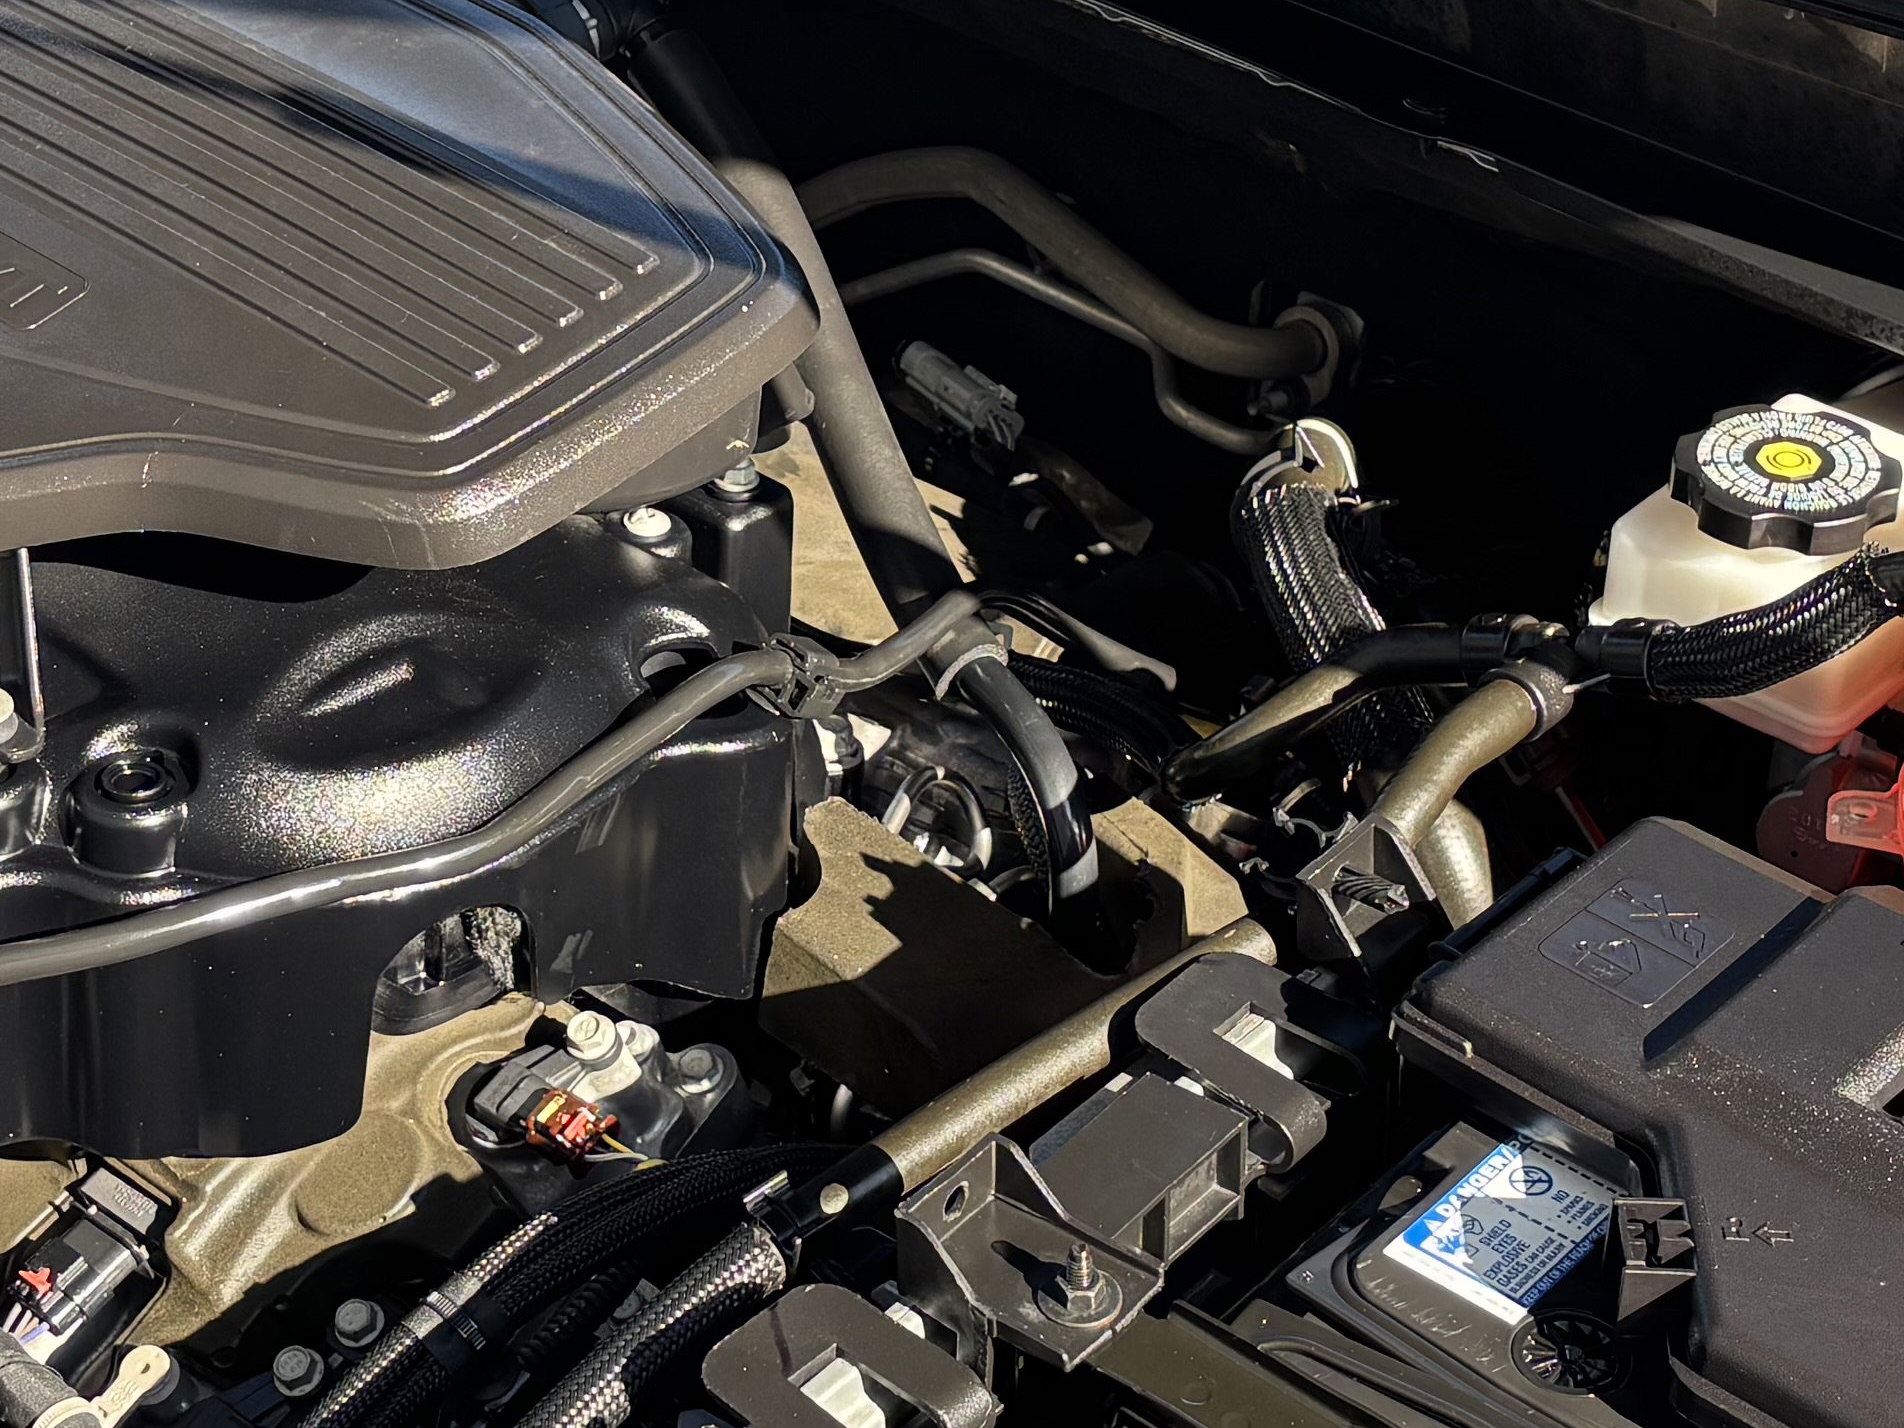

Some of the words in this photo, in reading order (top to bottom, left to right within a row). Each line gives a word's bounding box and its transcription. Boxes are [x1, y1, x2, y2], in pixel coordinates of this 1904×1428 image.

[1552, 1188, 1568, 1204] NO
[1479, 1217, 1511, 1247] SHIELD
[1492, 1232, 1517, 1255] EYES
[1484, 1238, 1530, 1281] EXPLOSIVE
[1497, 1259, 1527, 1288] GASES
